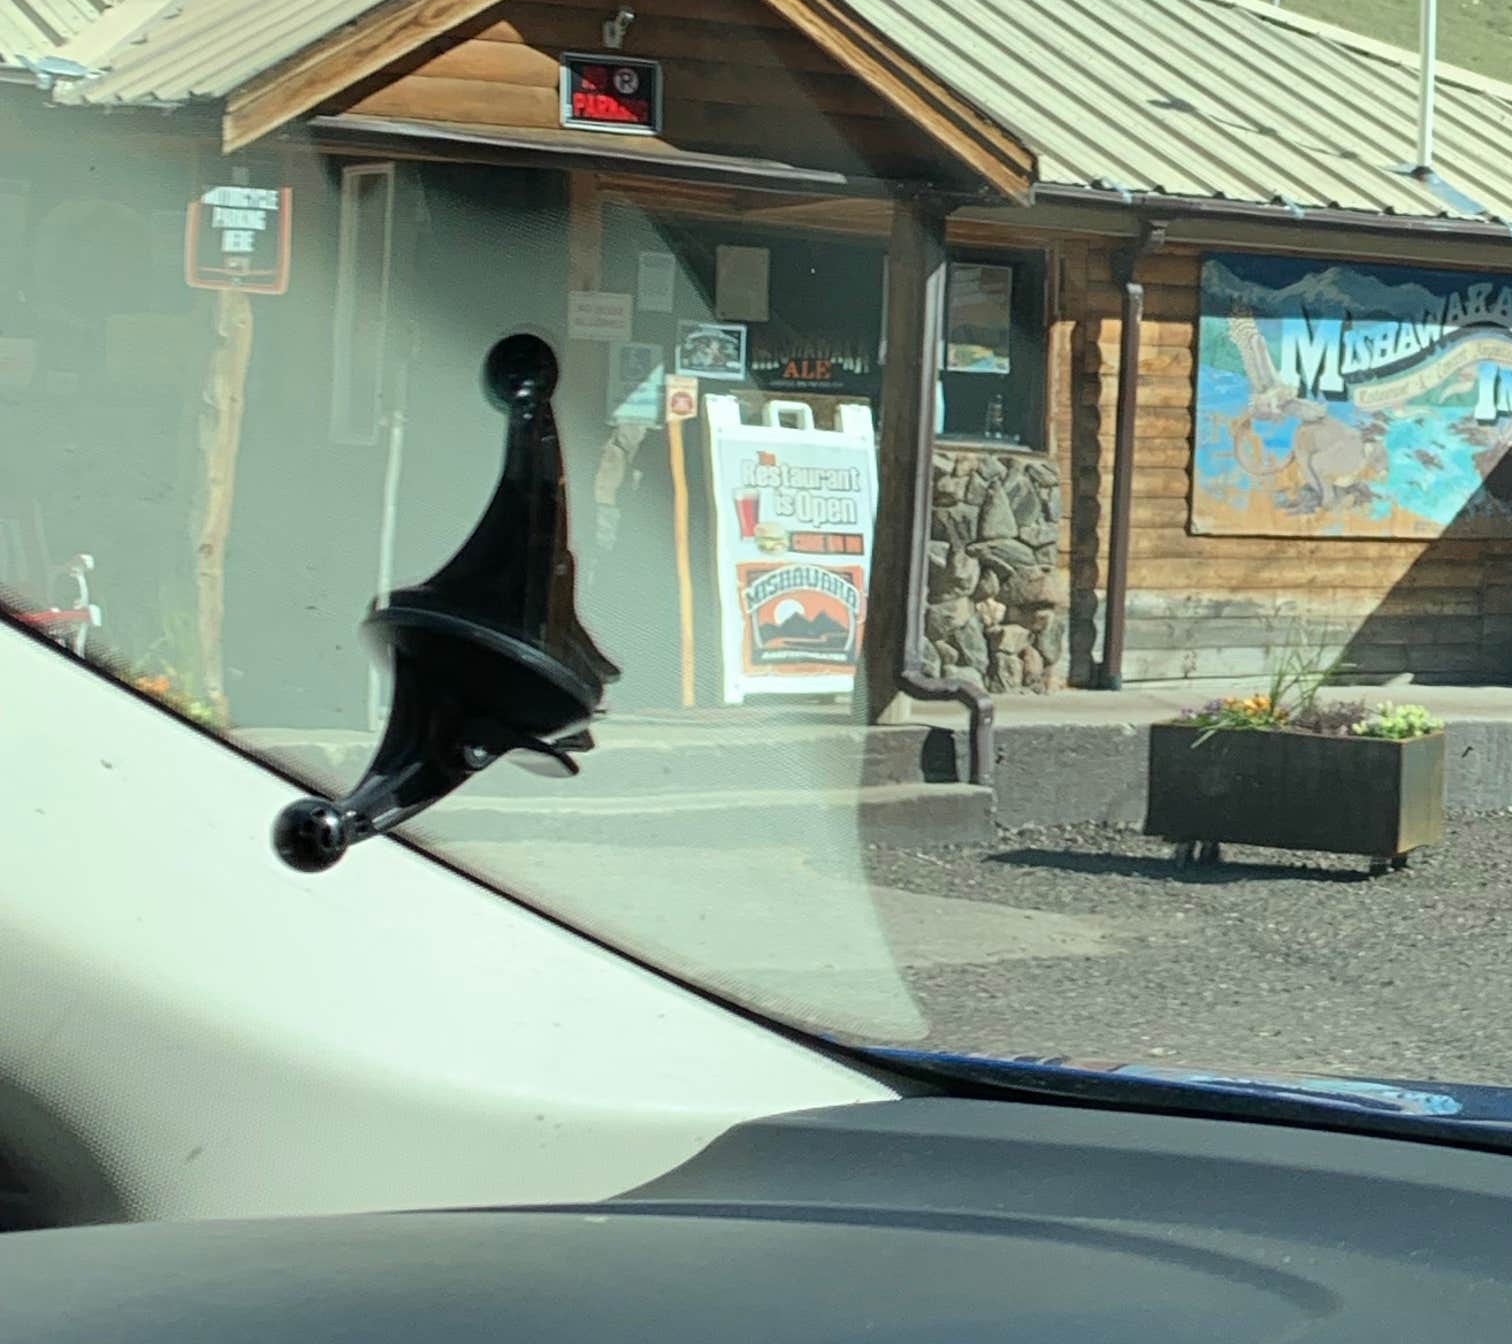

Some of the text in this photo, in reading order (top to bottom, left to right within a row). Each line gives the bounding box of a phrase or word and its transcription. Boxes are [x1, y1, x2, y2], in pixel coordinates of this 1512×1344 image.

[783, 360, 832, 379] ALE
[742, 459, 862, 492] Restaurant
[795, 491, 858, 528] Open
